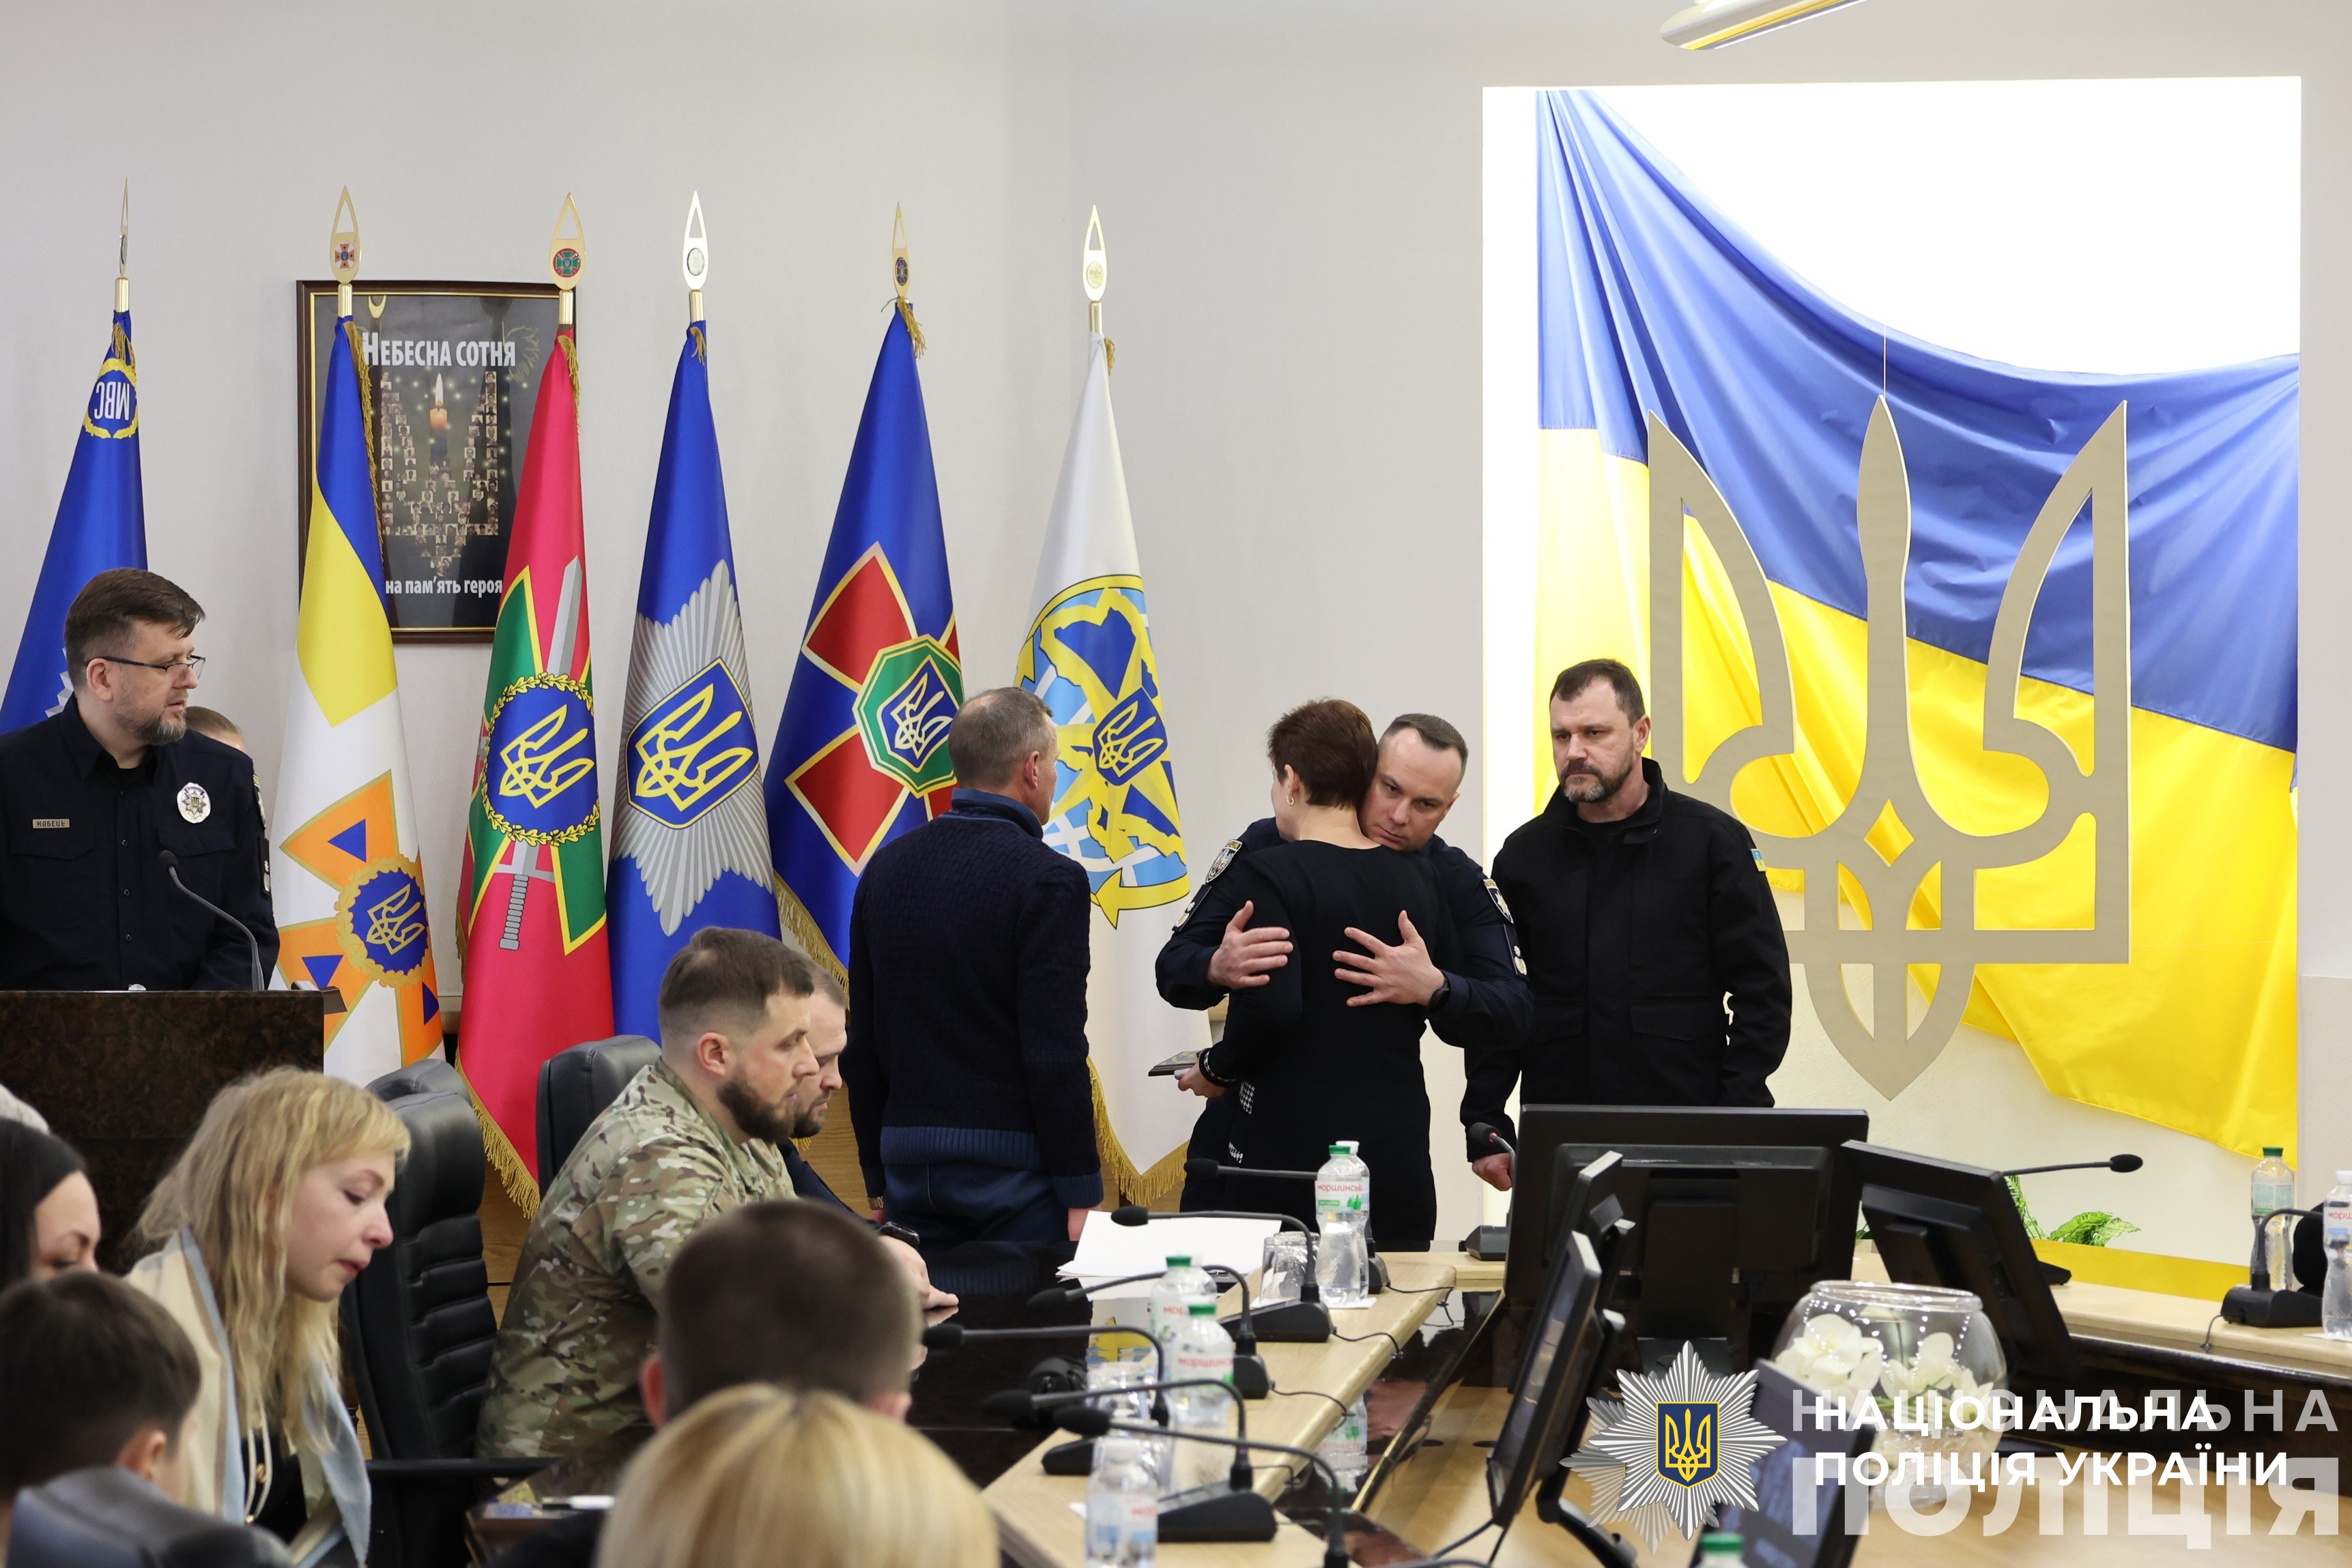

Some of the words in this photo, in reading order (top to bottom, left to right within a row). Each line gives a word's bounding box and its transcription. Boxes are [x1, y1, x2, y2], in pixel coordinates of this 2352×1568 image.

[456, 340, 516, 366] СОТНЯ
[94, 381, 130, 421] МВС
[464, 579, 503, 598] героя
